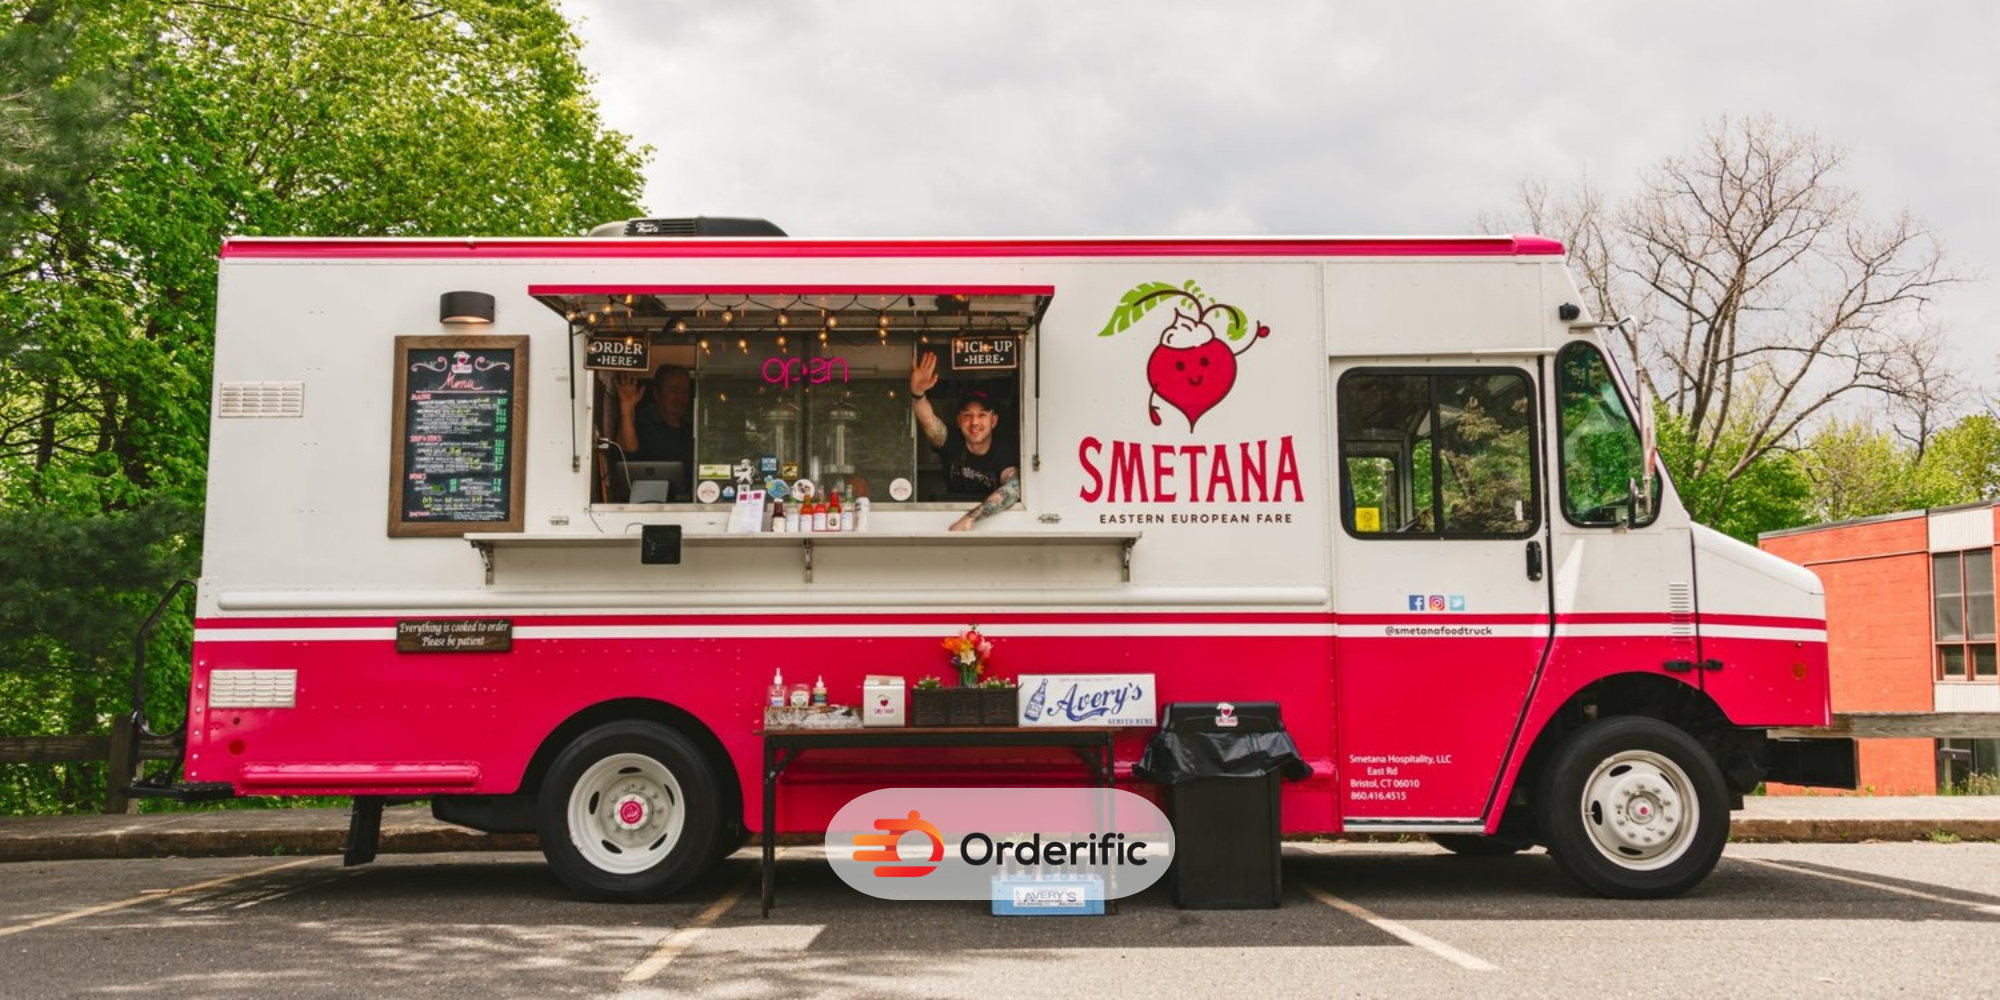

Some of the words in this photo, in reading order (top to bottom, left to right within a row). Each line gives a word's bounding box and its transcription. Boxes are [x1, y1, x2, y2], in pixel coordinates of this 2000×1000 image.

[591, 341, 642, 355] ORDER
[762, 356, 849, 388] open
[439, 372, 484, 390] Menu
[1079, 436, 1304, 503] SMETANA
[1099, 514, 1165, 523] EASTERN
[1171, 514, 1250, 523] EUROPEAN
[1257, 514, 1292, 523] FARE
[399, 621, 443, 636] Everything
[443, 622, 450, 632] is
[451, 621, 477, 632] cooked
[478, 622, 486, 632] to
[487, 620, 509, 632] order
[1385, 626, 1493, 636] @smetanafoodtruck
[422, 634, 445, 646] Please
[447, 634, 455, 646] be
[455, 635, 485, 649] patient
[1047, 682, 1143, 722] Avery's
[1349, 754, 1386, 764] Smetana
[1387, 754, 1435, 765] Hospitality,
[1436, 755, 1452, 764] LLC
[1367, 767, 1385, 776] East
[1386, 767, 1398, 776] Rd
[1350, 779, 1379, 789] Bristol,
[1380, 779, 1391, 788] CT
[1393, 779, 1420, 788] 06010
[1350, 791, 1407, 800] 860.416.4515
[1023, 891, 1077, 903] AVERY'S
